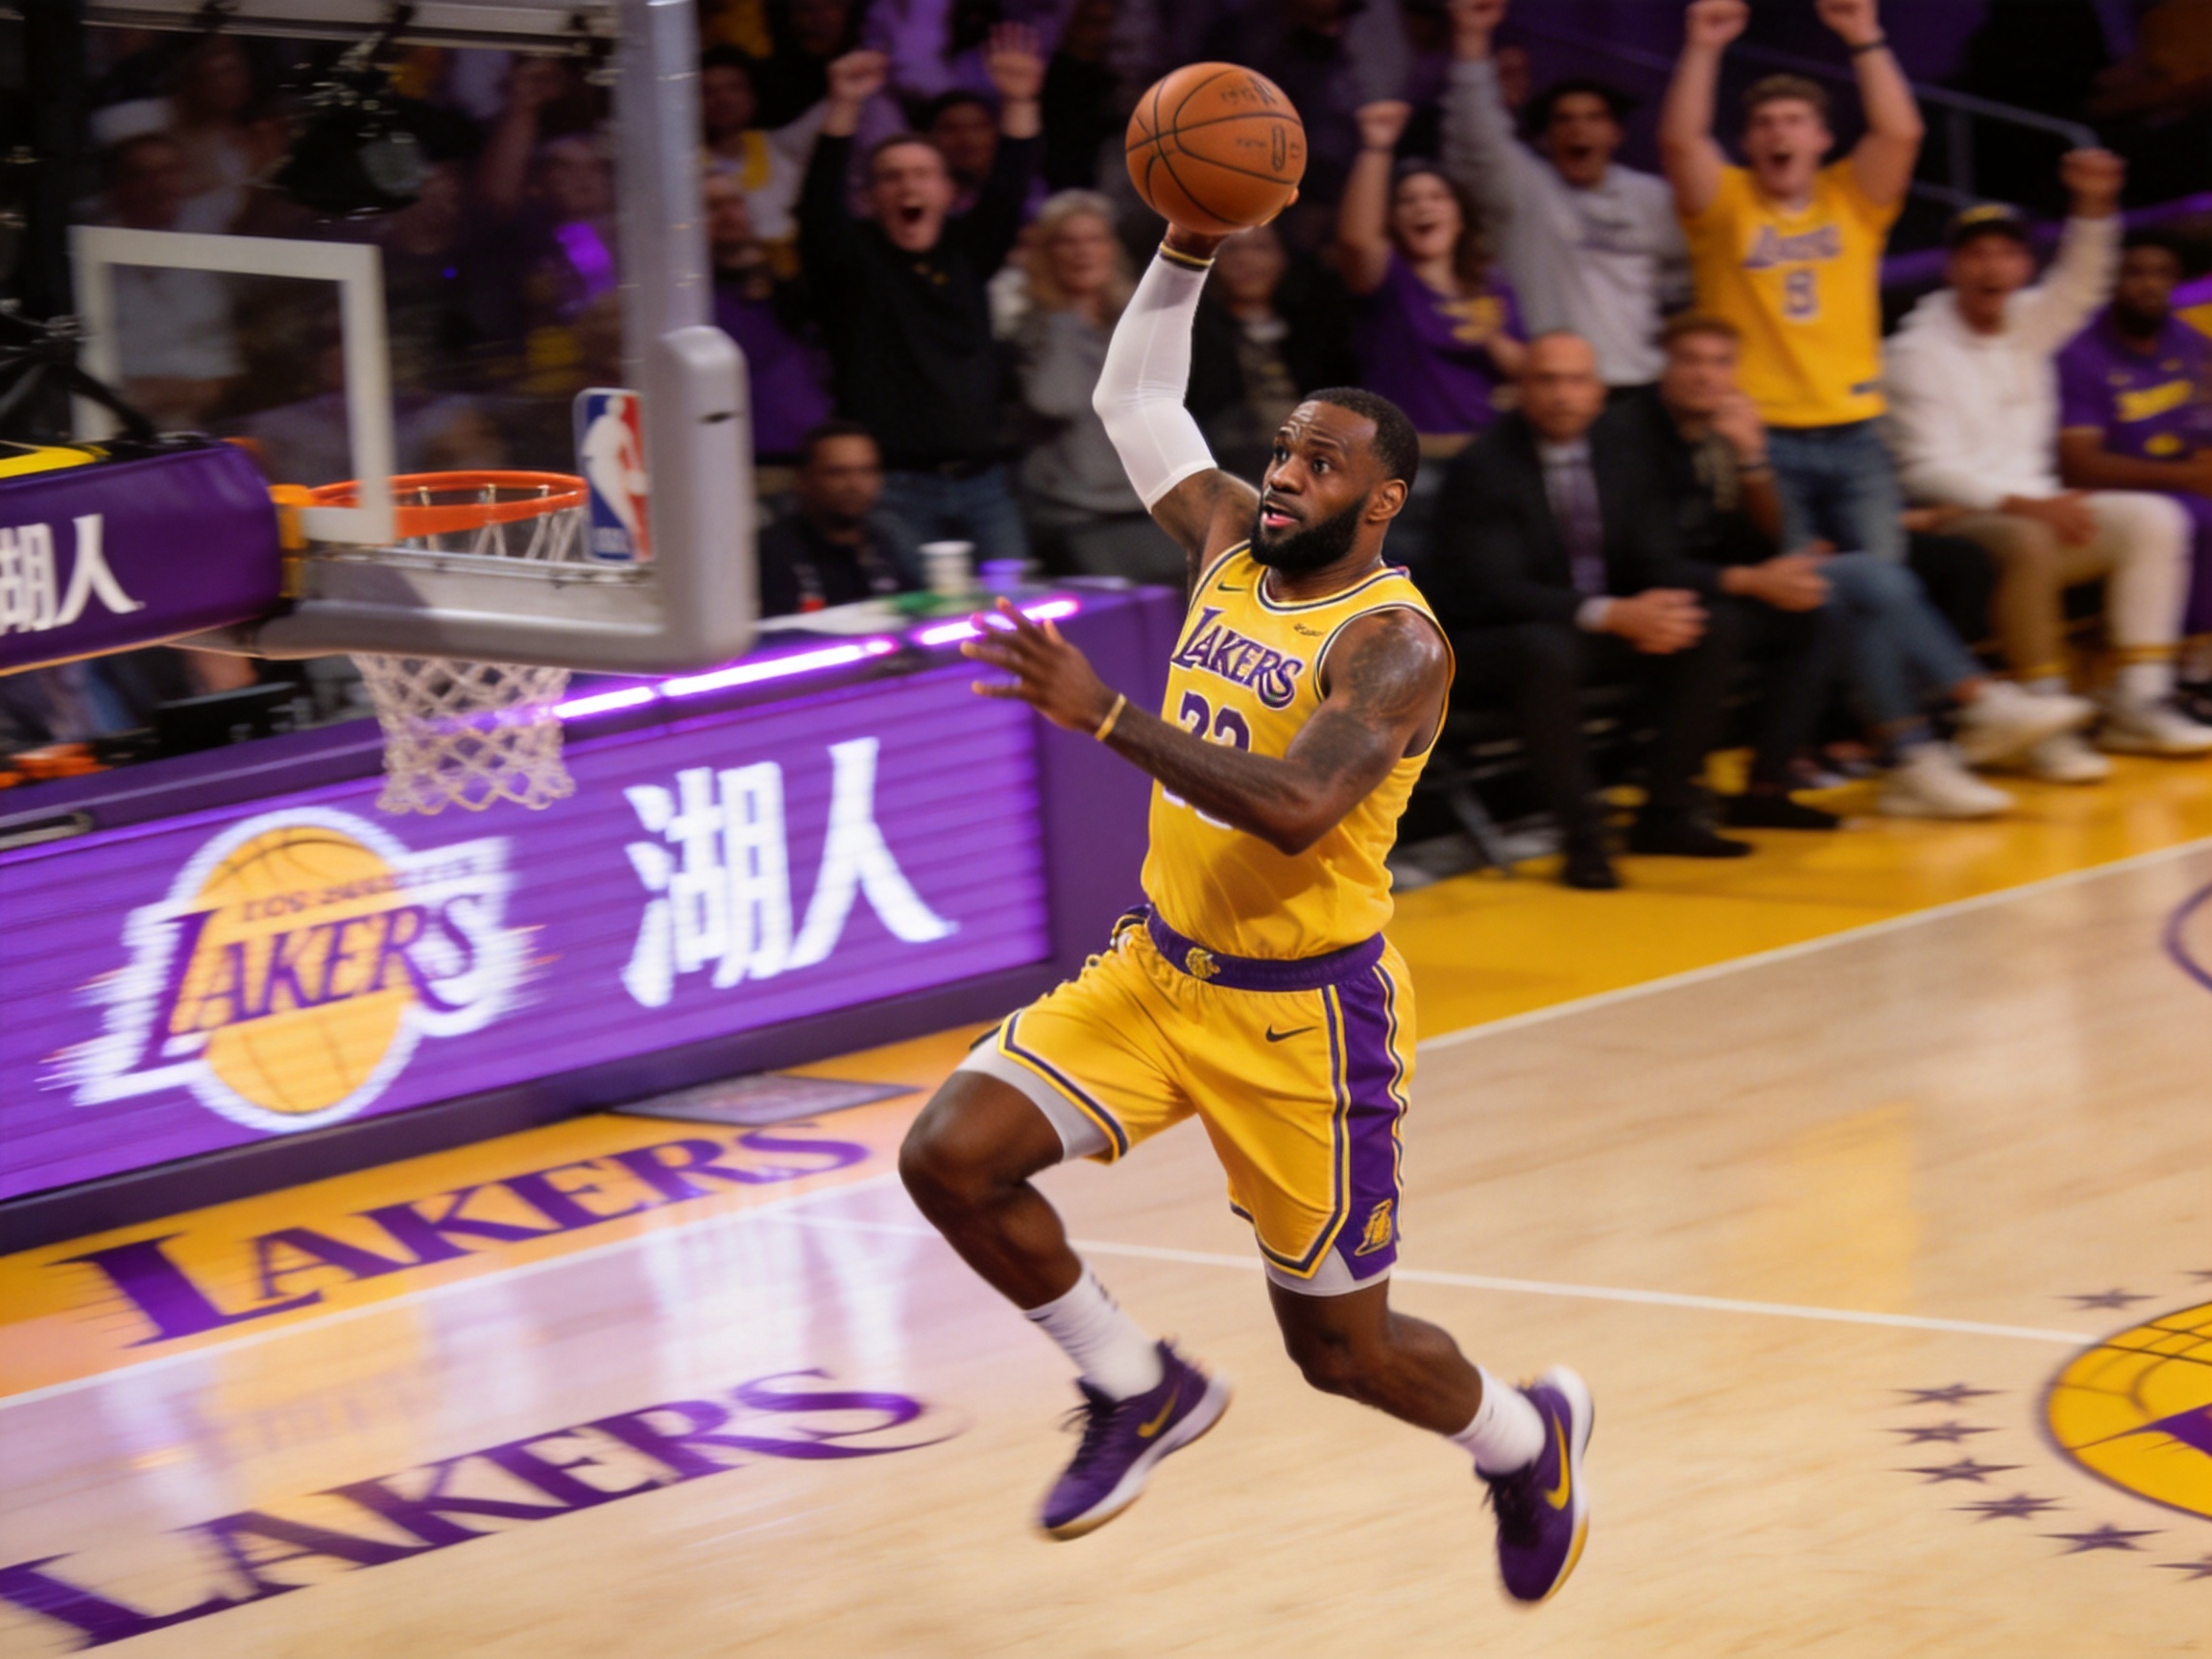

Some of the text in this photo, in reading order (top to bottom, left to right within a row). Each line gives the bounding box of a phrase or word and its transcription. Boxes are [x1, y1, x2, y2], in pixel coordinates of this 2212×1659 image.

[1170, 605, 1305, 711] LAKERS
[125, 891, 486, 1075] LAKERS
[620, 735, 960, 1008] 湖人
[43, 1121, 872, 1349] LAKERS
[0, 1367, 974, 1653] LAKERS
